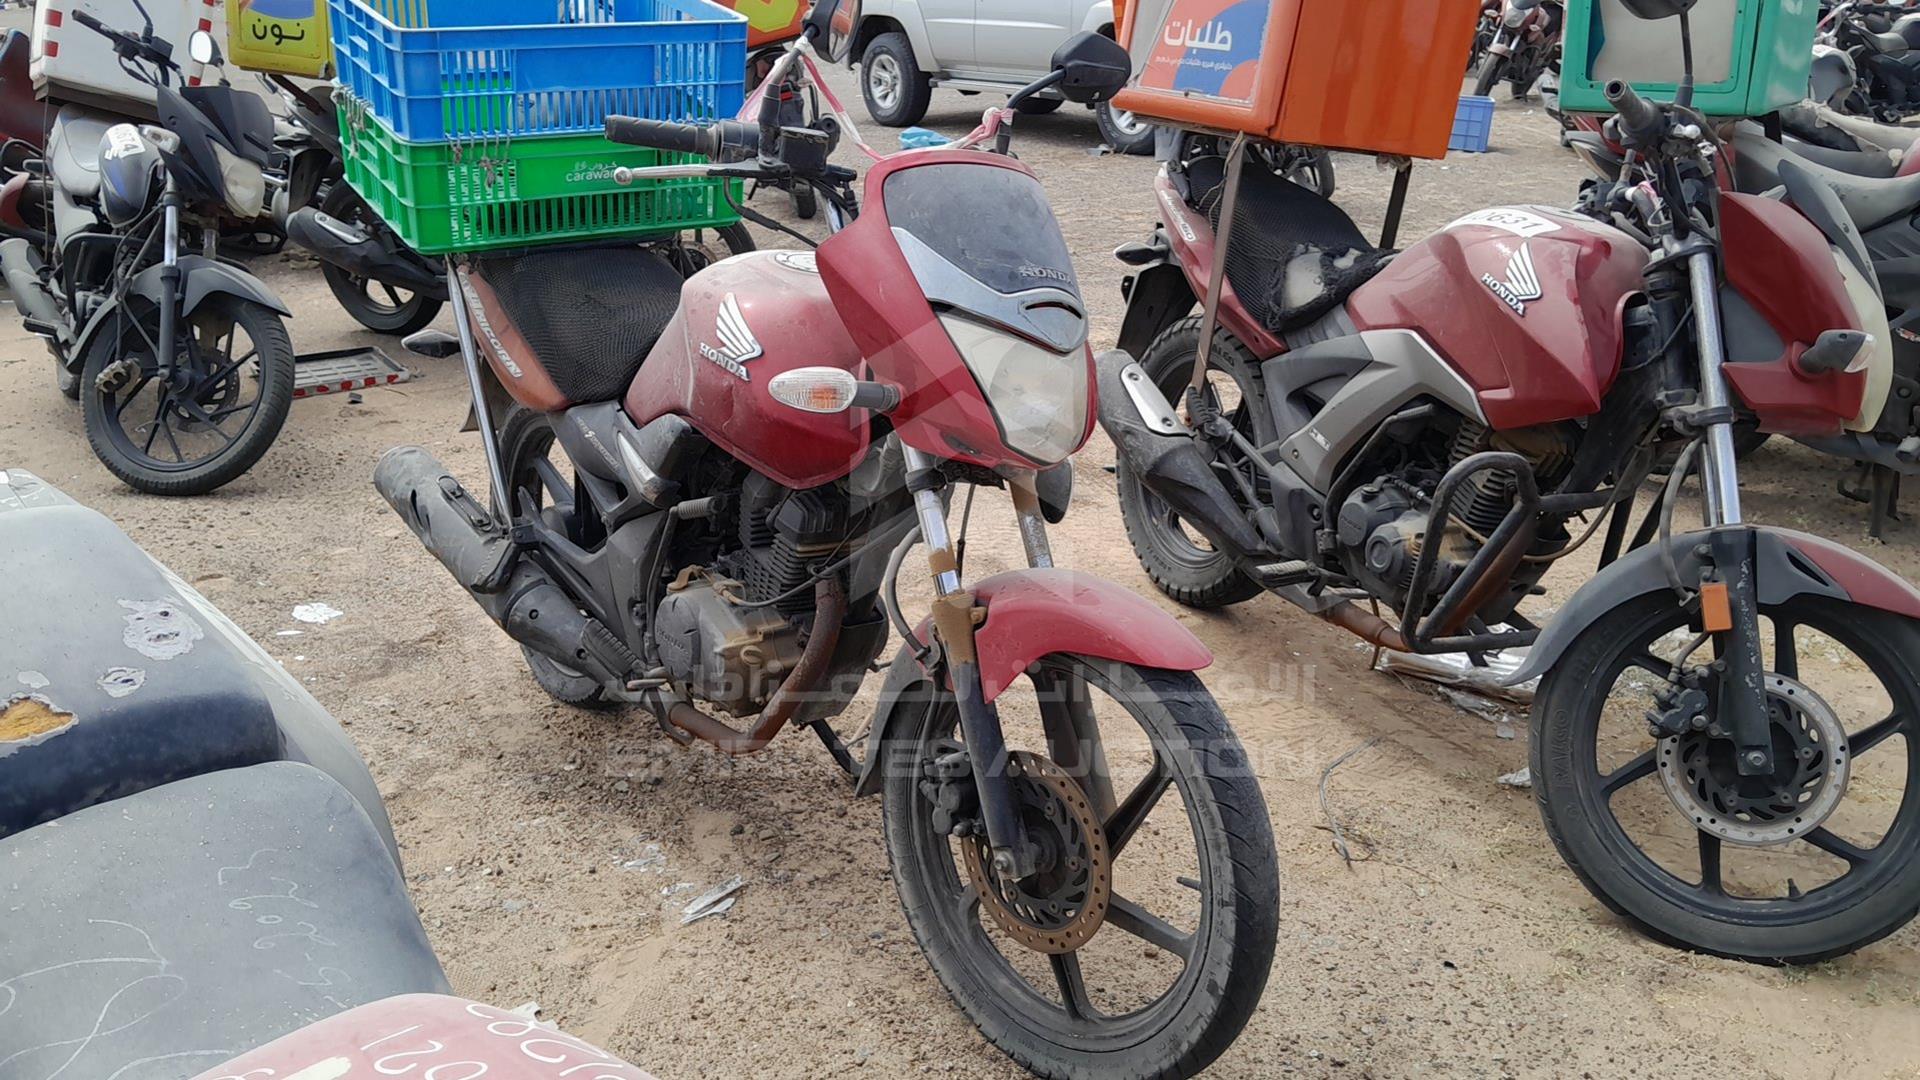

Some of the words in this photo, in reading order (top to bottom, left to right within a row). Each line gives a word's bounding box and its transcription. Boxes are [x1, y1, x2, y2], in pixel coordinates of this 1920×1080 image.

[250, 18, 305, 46] نون
[1163, 19, 1232, 54] طلبات
[1480, 272, 1526, 318] HONDA
[699, 341, 751, 382] HONDA
